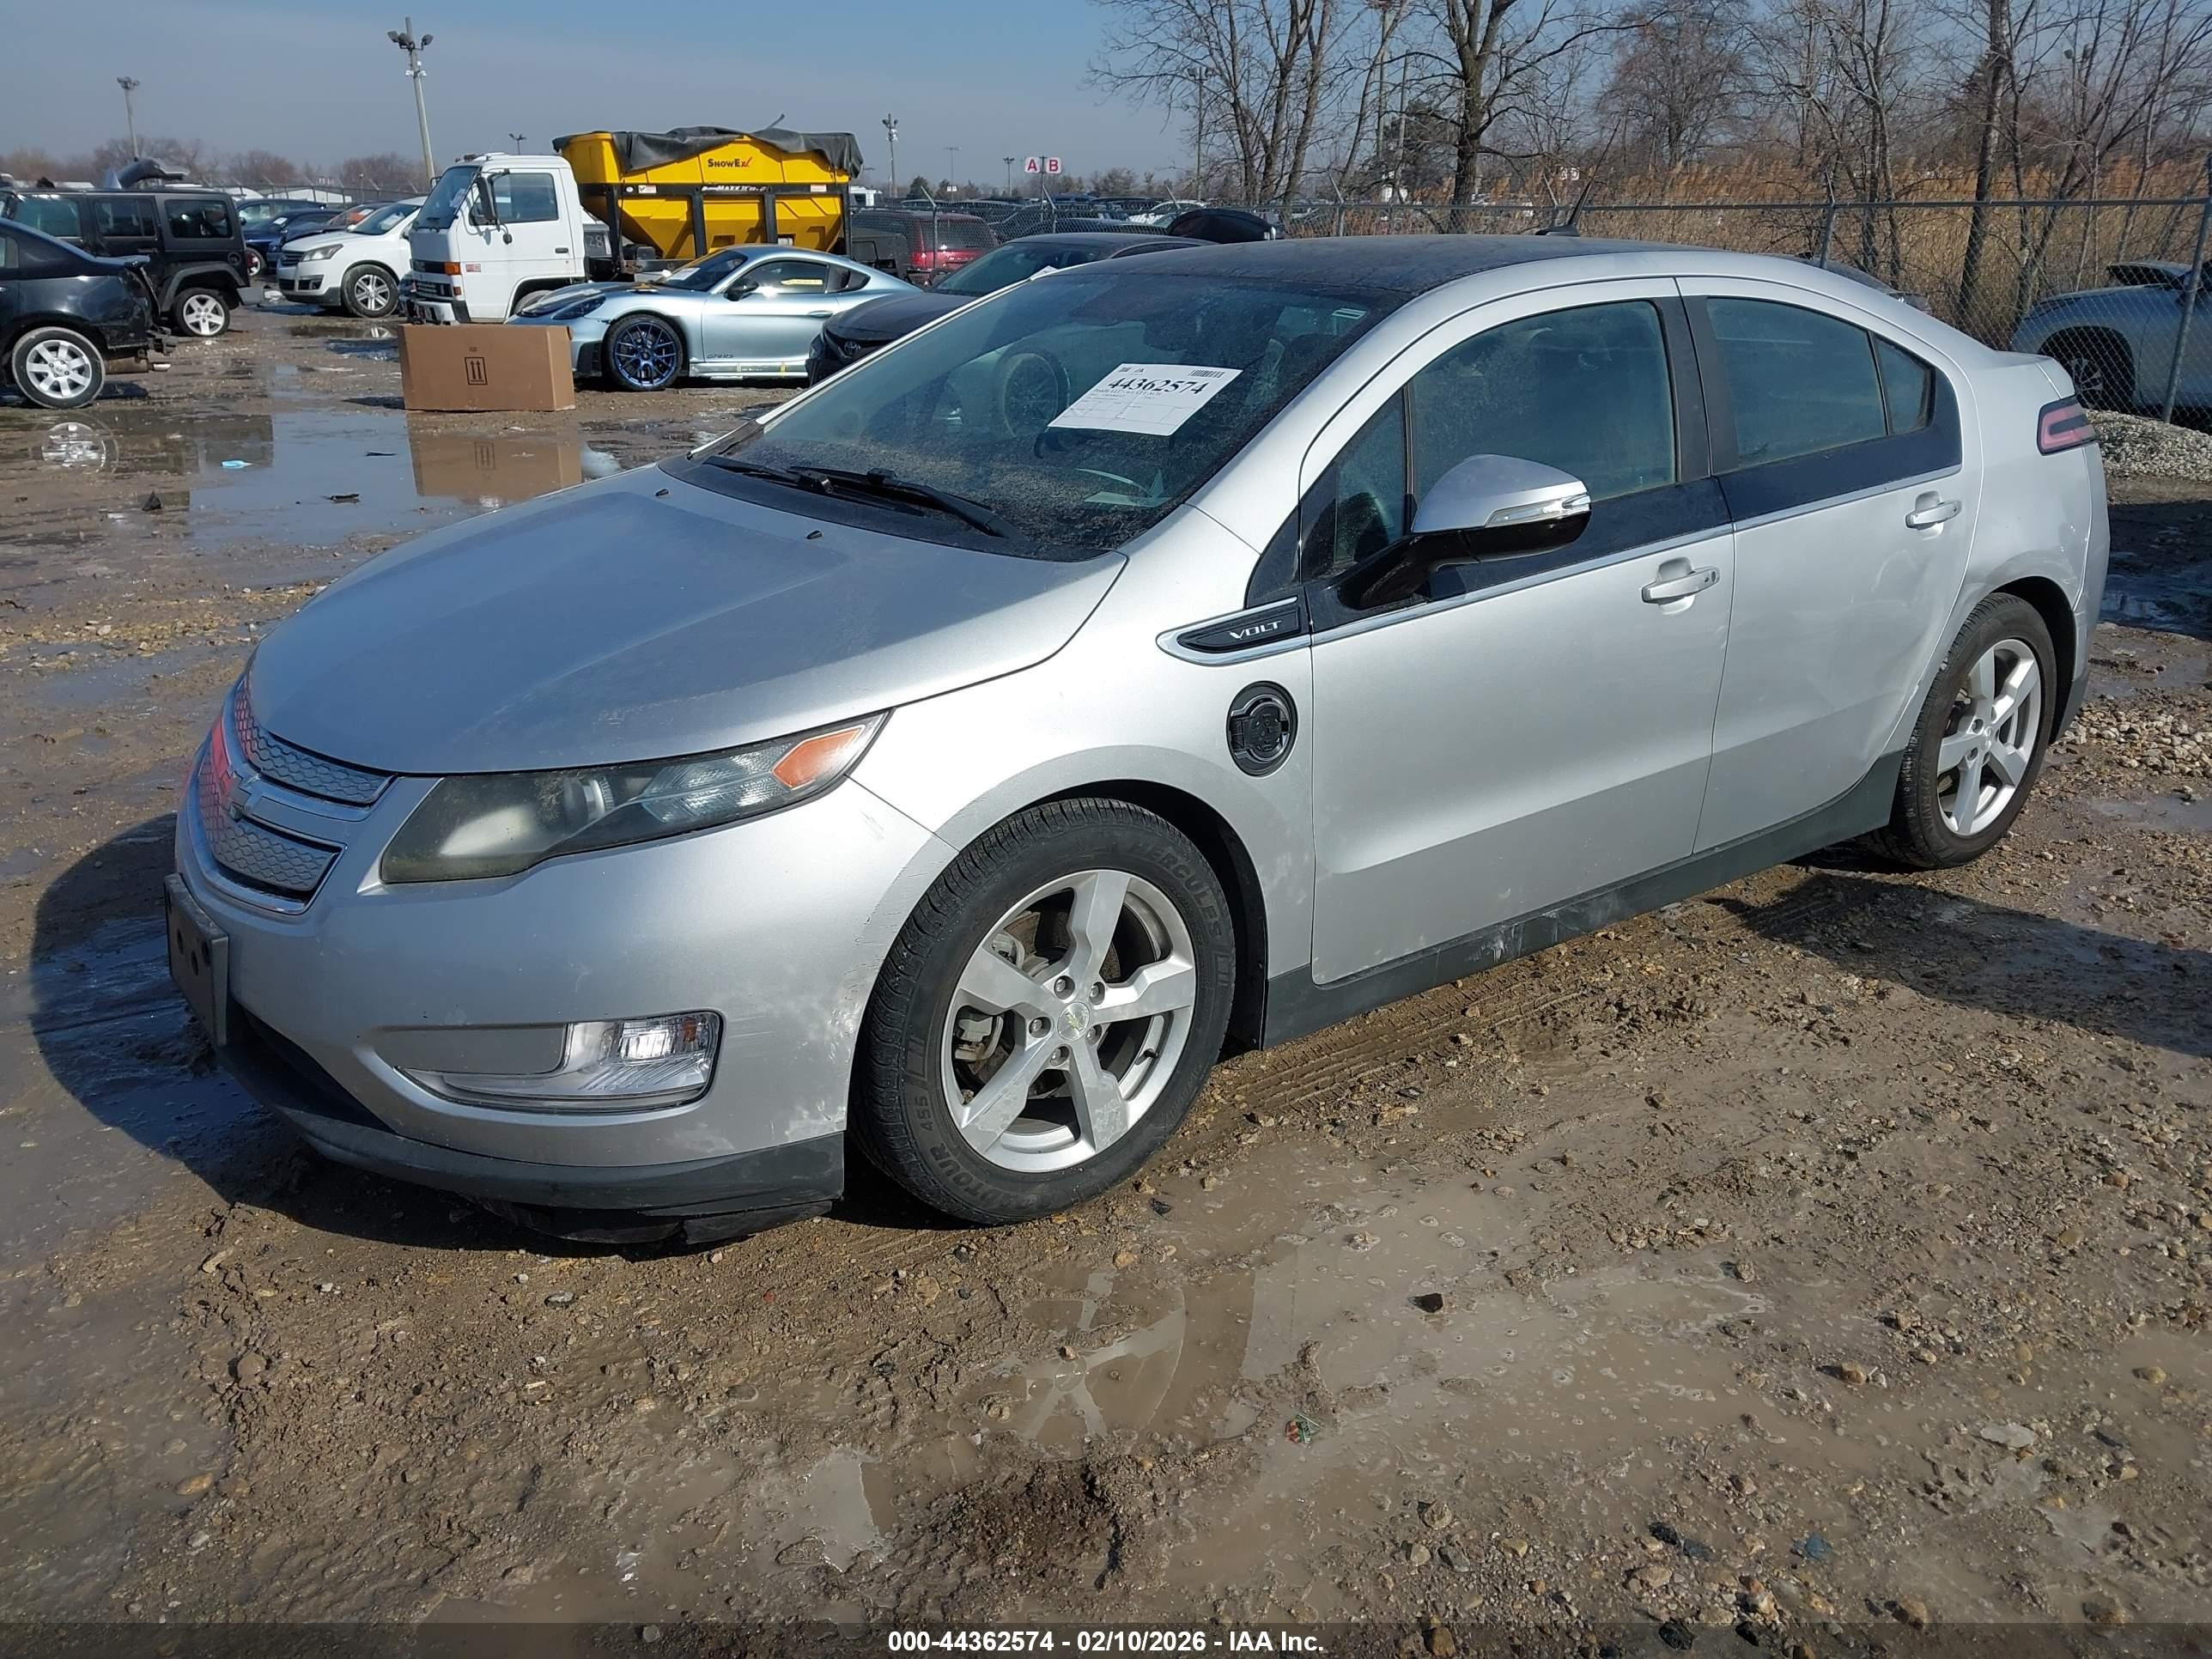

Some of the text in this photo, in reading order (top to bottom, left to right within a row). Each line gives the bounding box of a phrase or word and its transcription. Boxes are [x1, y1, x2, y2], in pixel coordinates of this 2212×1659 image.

[1027, 158, 1038, 172] A
[1048, 159, 1059, 172] B
[1109, 377, 1210, 395] 44362574
[1227, 620, 1282, 641] VOLT
